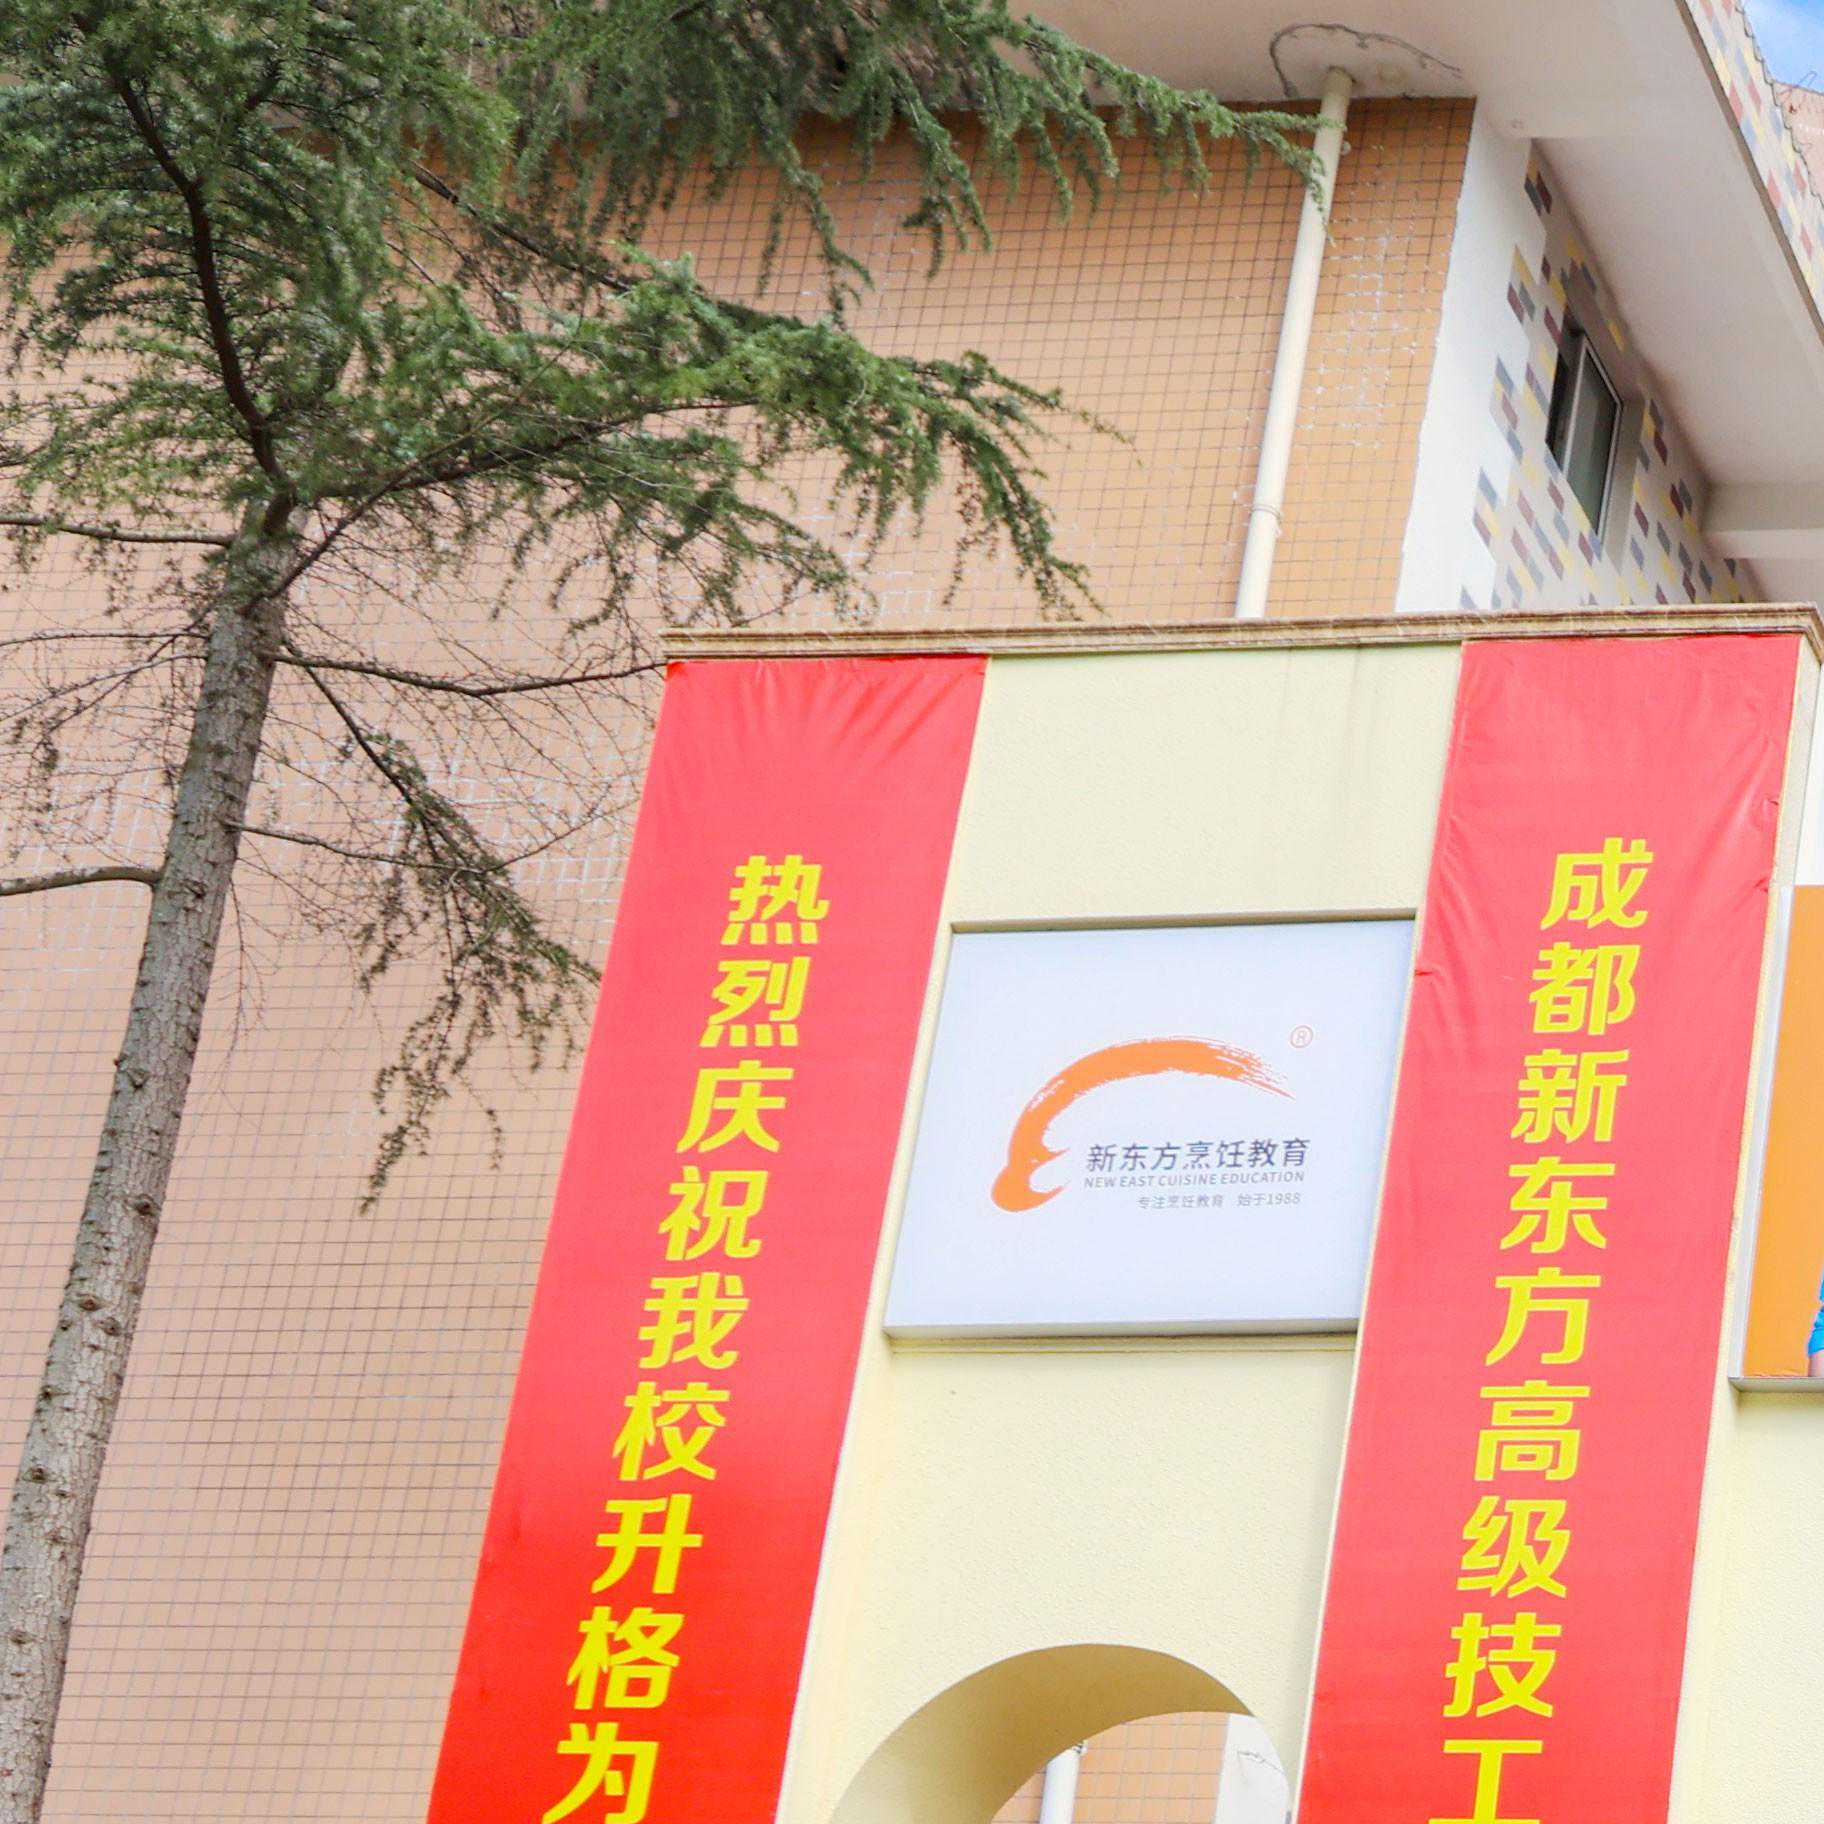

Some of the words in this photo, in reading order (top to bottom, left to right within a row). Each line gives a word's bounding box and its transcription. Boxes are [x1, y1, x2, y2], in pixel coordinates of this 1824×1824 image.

[1086, 1137, 1310, 1173] 新东方烹饪教育
[1084, 1176, 1117, 1188] NEW
[1120, 1175, 1154, 1187] EAST
[1158, 1173, 1217, 1187] CUISINE
[1220, 1171, 1305, 1184] EDUCATION
[1236, 1192, 1300, 1207] 始于1988
